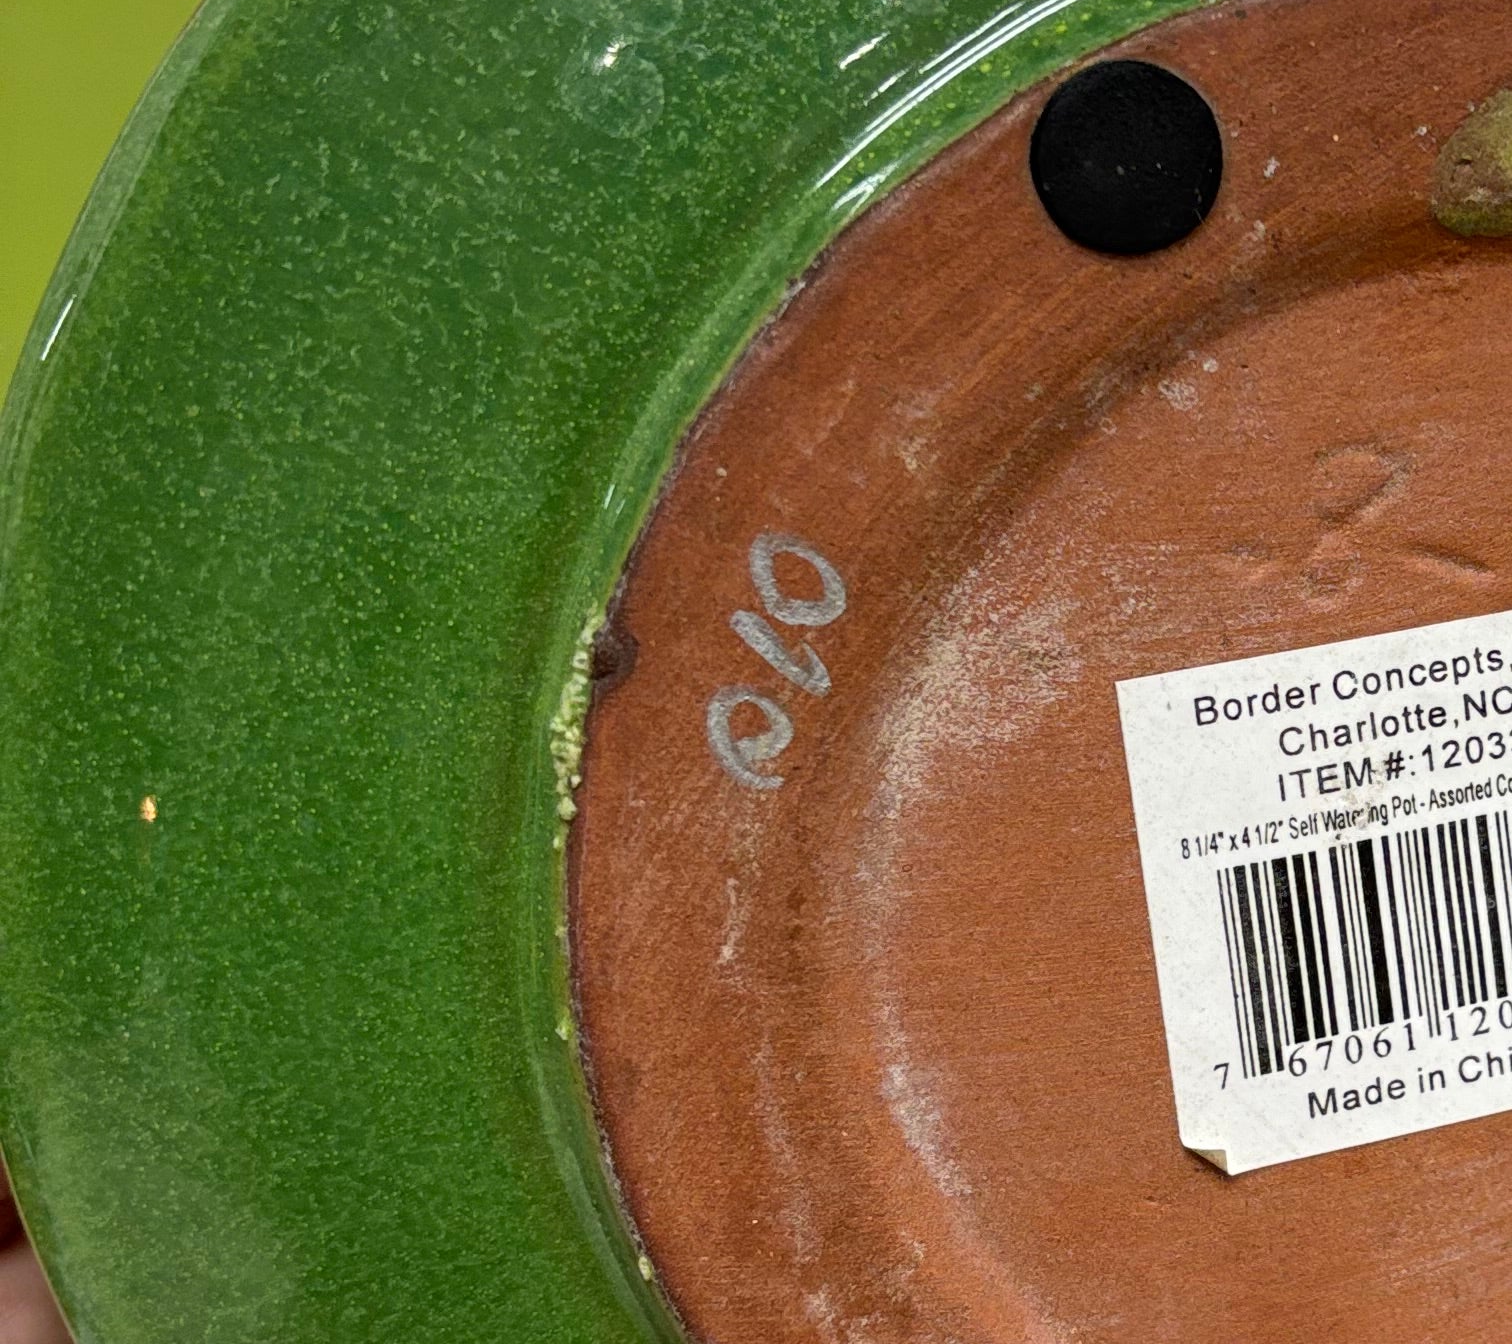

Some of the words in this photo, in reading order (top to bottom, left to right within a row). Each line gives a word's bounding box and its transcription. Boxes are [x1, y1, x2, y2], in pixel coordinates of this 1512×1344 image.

[1193, 683, 1321, 726] Border
[1278, 757, 1374, 802] ITEM
[1181, 838, 1190, 860] 8
[1195, 831, 1224, 856] 1/4"
[1229, 834, 1239, 851] x
[1242, 826, 1251, 848] 4
[1255, 820, 1284, 846] 1/2"
[1288, 813, 1319, 840] Self
[1391, 793, 1419, 819] Pot
[1428, 777, 1493, 811] Assorted
[1213, 1062, 1230, 1090] 7
[1288, 1022, 1417, 1077] 67061
[1308, 1078, 1406, 1119] Made
[1418, 1067, 1447, 1093] in
